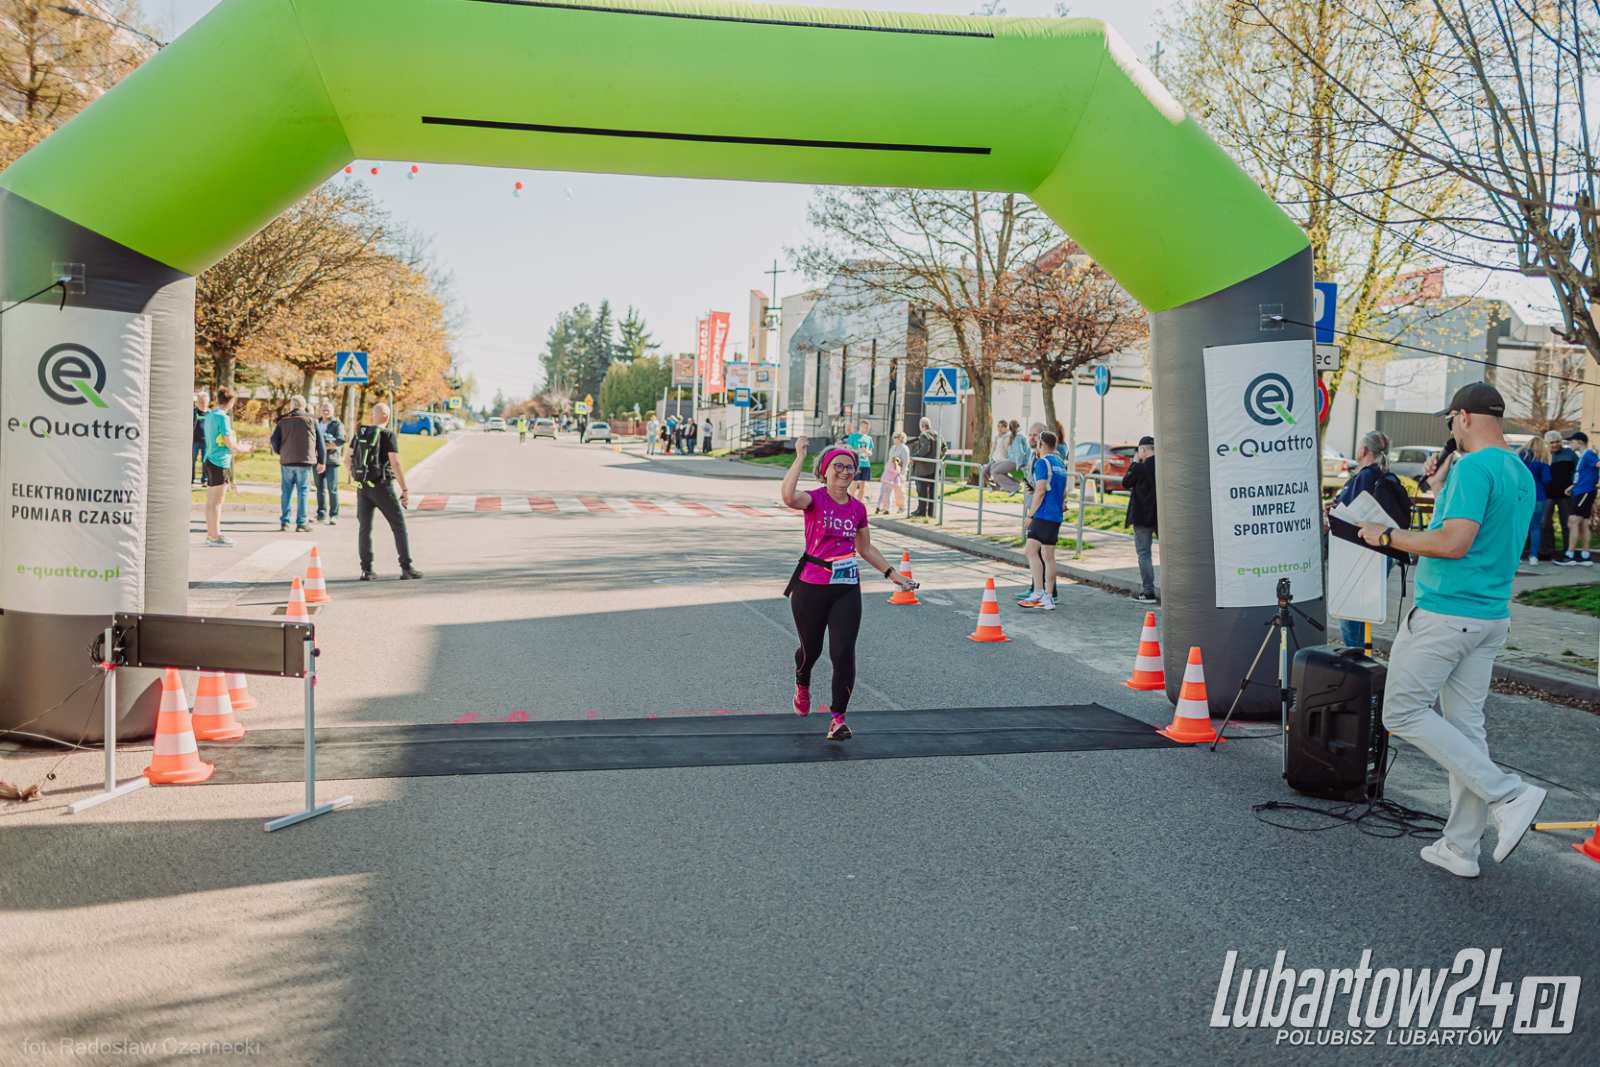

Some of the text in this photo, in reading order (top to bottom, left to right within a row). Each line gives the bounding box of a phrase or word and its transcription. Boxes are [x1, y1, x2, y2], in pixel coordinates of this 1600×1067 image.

[11, 482, 134, 504] ELEKTRONICZNY
[1230, 481, 1309, 499] ORGANIZACJA
[11, 505, 133, 525] POMIAR CZASU
[1252, 501, 1296, 517] IMPREZ
[1234, 517, 1311, 537] SPORTOWYCH
[16, 563, 122, 580] e-quattro.pl
[1237, 560, 1312, 577] e-quattro.pl
